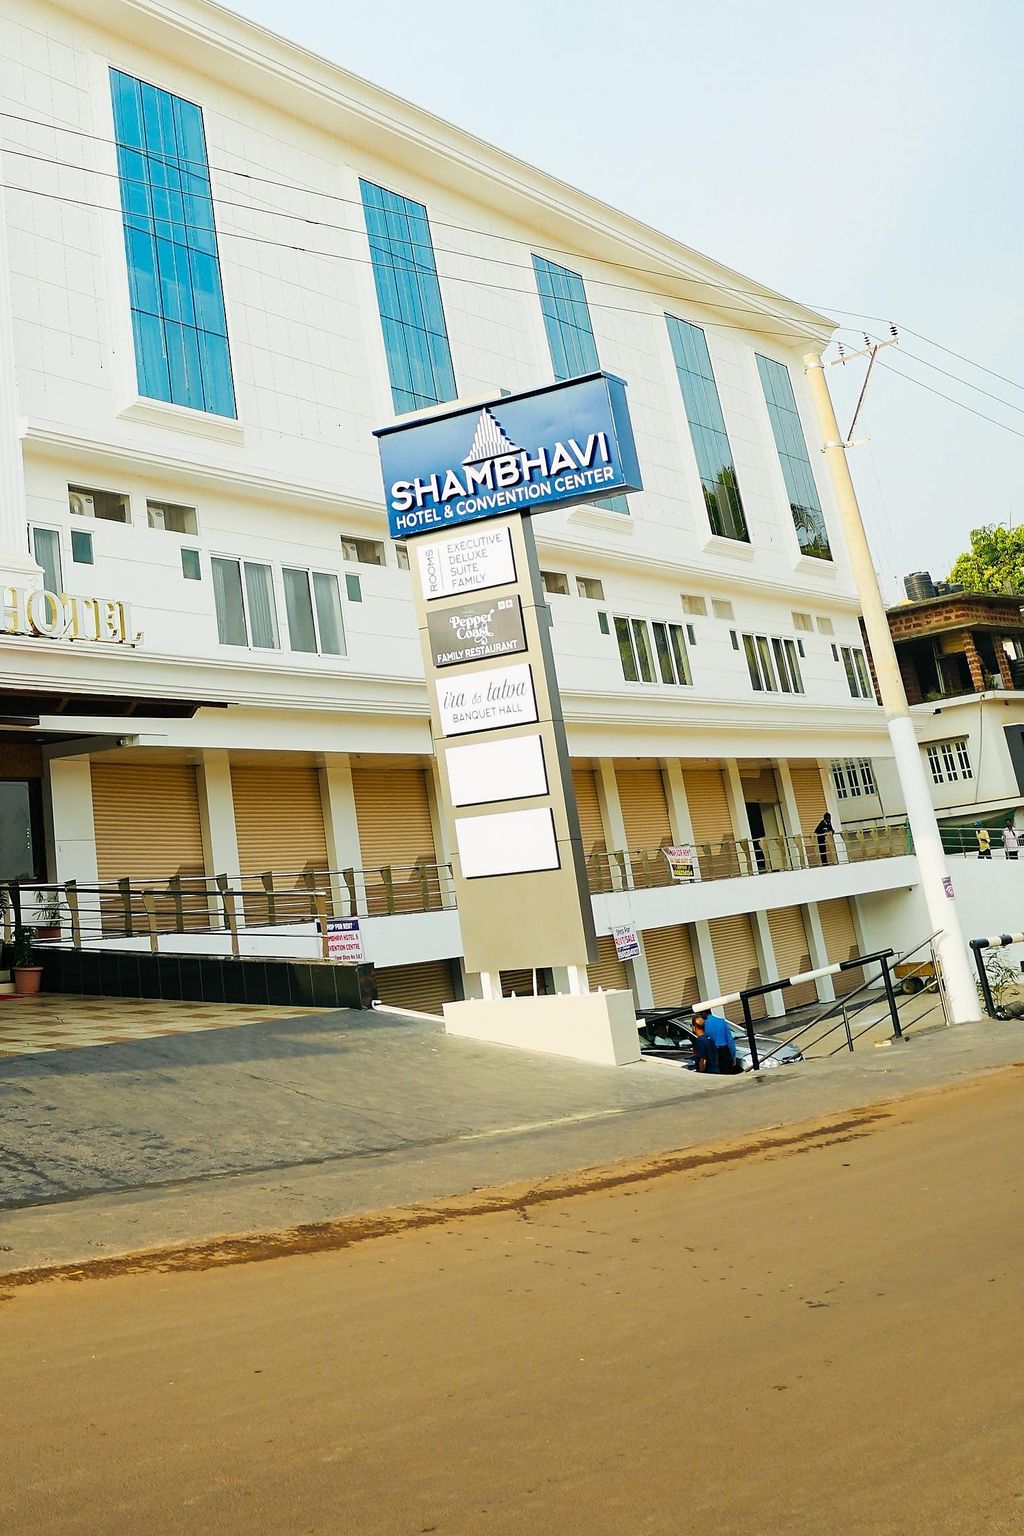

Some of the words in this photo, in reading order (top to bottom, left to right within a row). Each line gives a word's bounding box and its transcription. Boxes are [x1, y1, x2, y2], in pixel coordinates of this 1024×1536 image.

[391, 431, 609, 512] SHAMBHAVI
[396, 509, 443, 530] HOTEL
[444, 504, 455, 518] &
[456, 481, 552, 517] CONVENTION
[554, 466, 615, 493] CENTER
[447, 532, 503, 554] EXECUTIVE
[448, 548, 489, 565] DELUXE
[425, 549, 438, 593] ROOMS
[450, 562, 479, 577] SUITE
[451, 573, 486, 589] FAMILY
[449, 608, 495, 630] Pepper
[456, 624, 494, 645] Coast
[437, 649, 463, 663] FAMILY
[465, 639, 518, 658] RESTAURANT
[452, 706, 497, 723] BANQUET
[499, 703, 524, 714] HALL
